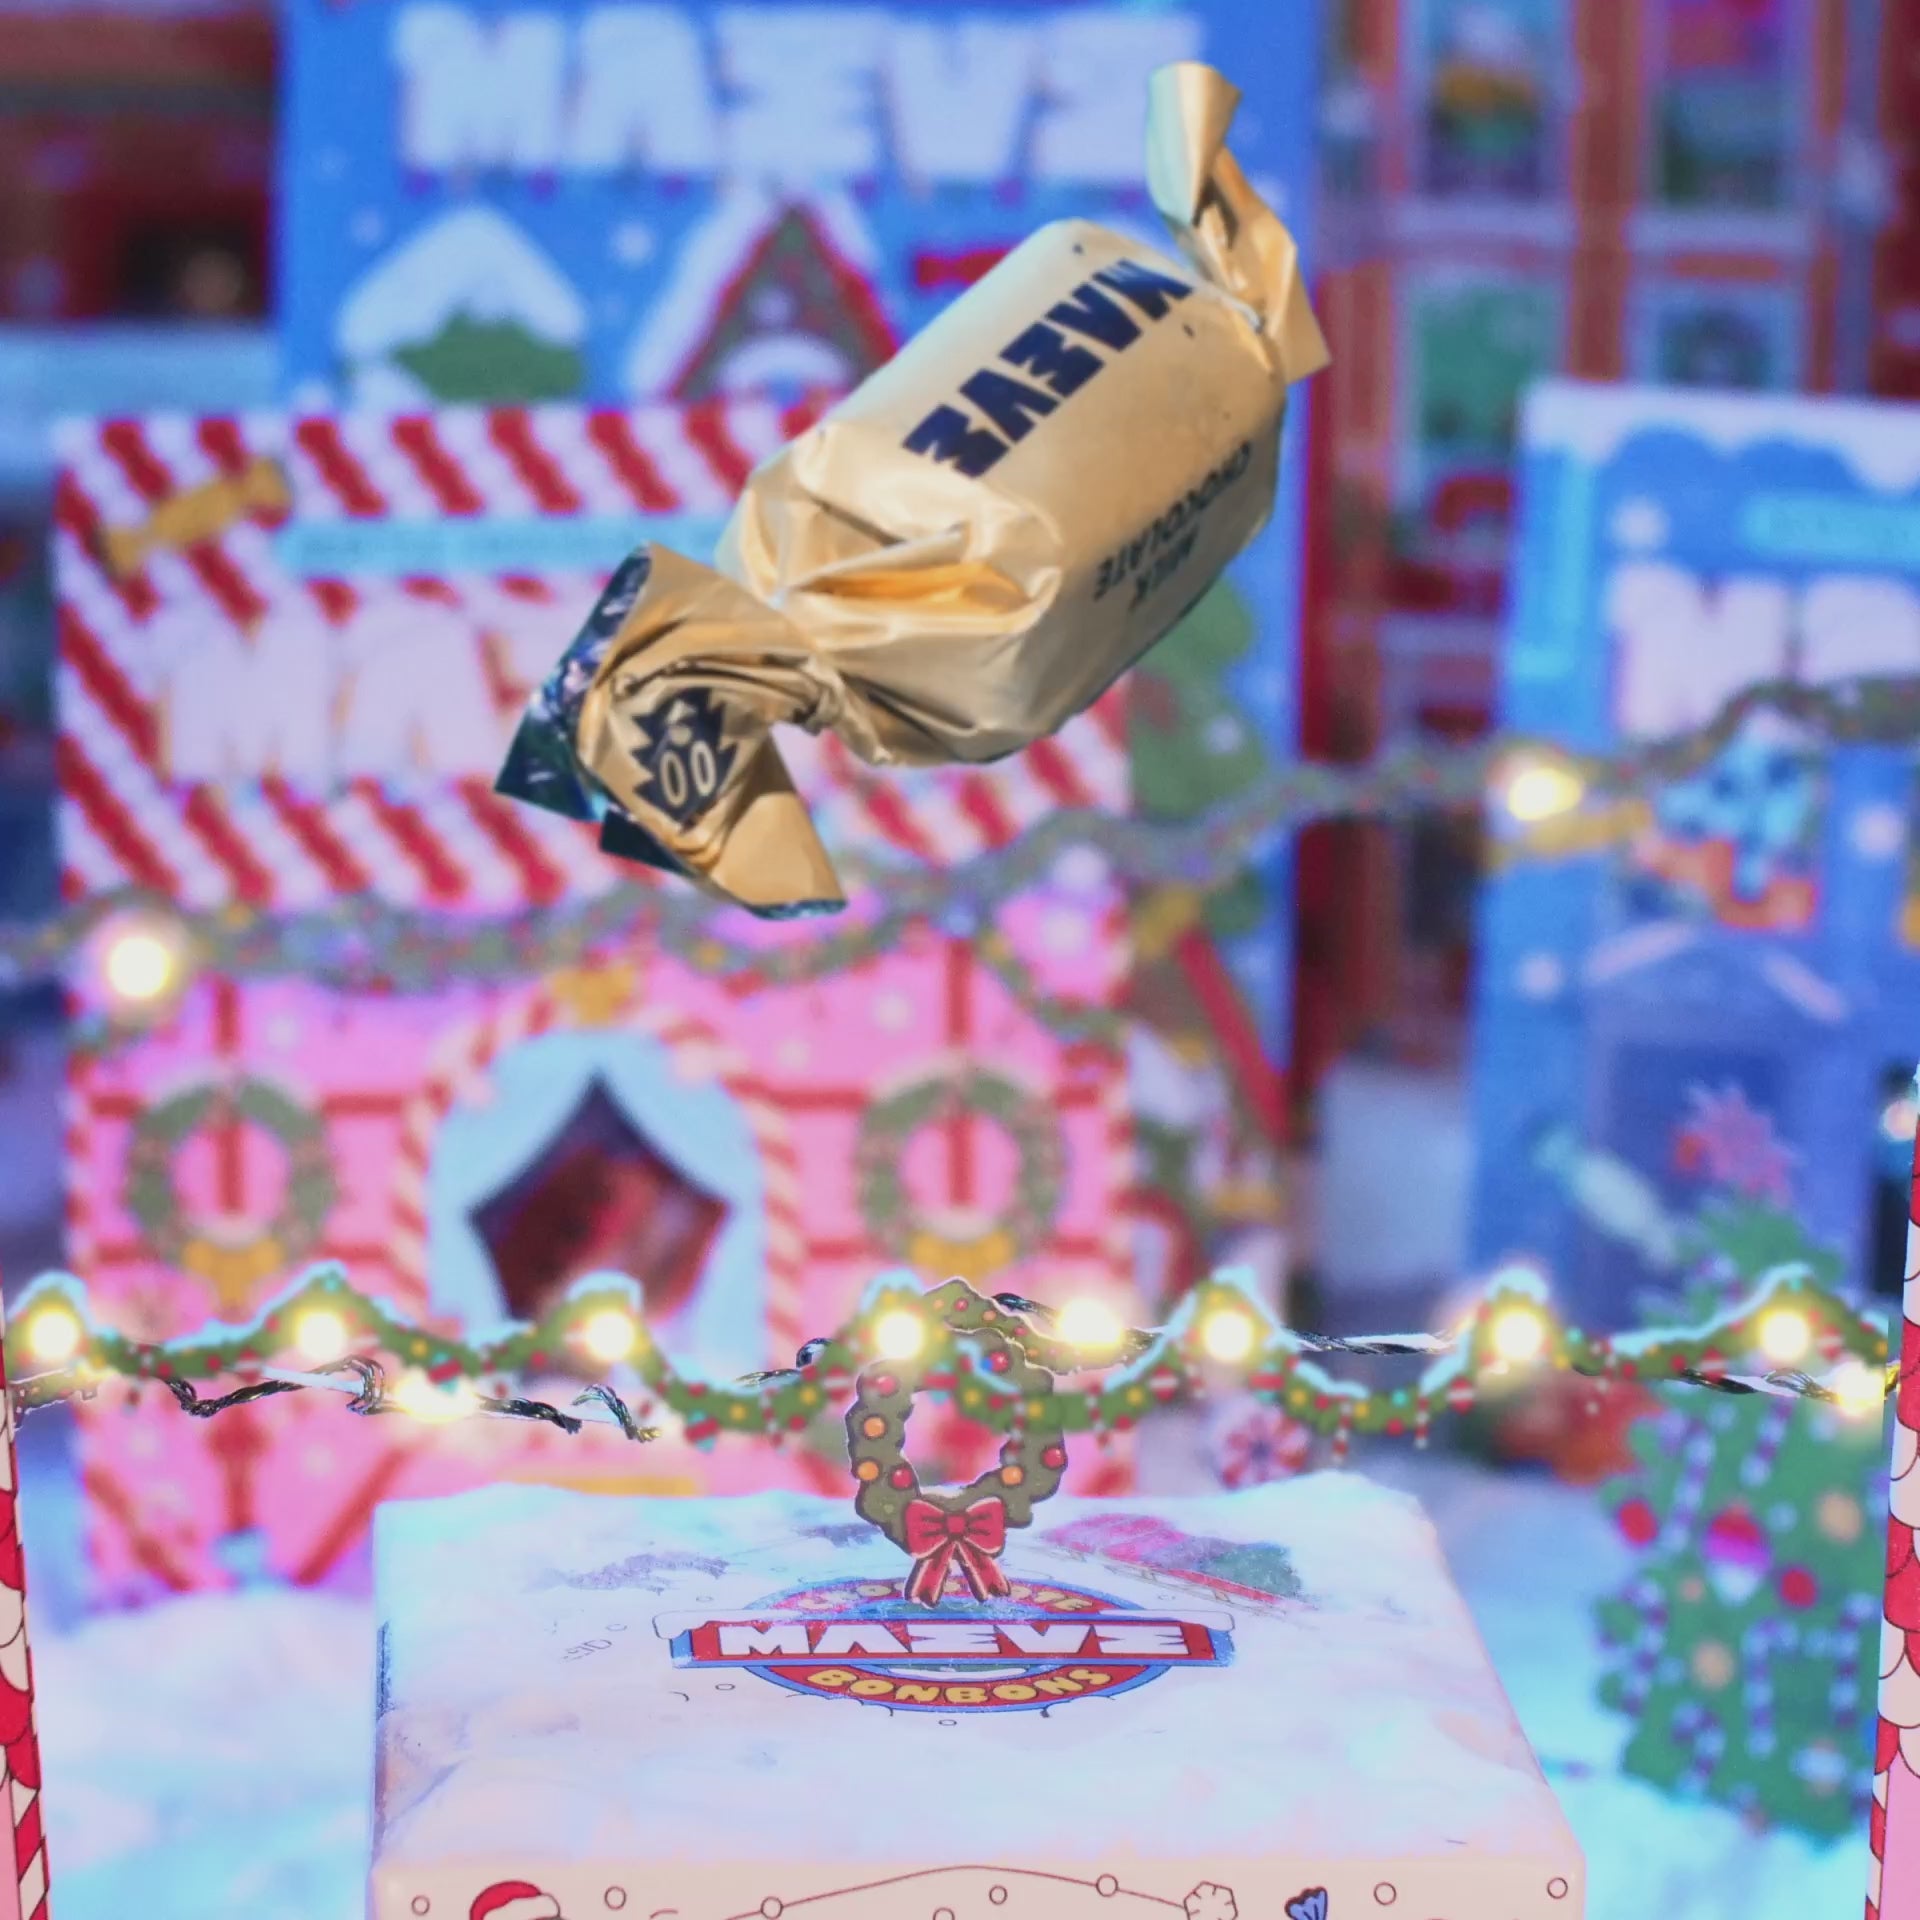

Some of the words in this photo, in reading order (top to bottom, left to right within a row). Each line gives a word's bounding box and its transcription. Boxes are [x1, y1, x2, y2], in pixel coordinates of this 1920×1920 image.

[393, 8, 1200, 174] MAEVE
[902, 257, 1194, 479] MAEVE
[717, 1623, 1192, 1656] MAEVE
[806, 1668, 1112, 1703] BONBONS
